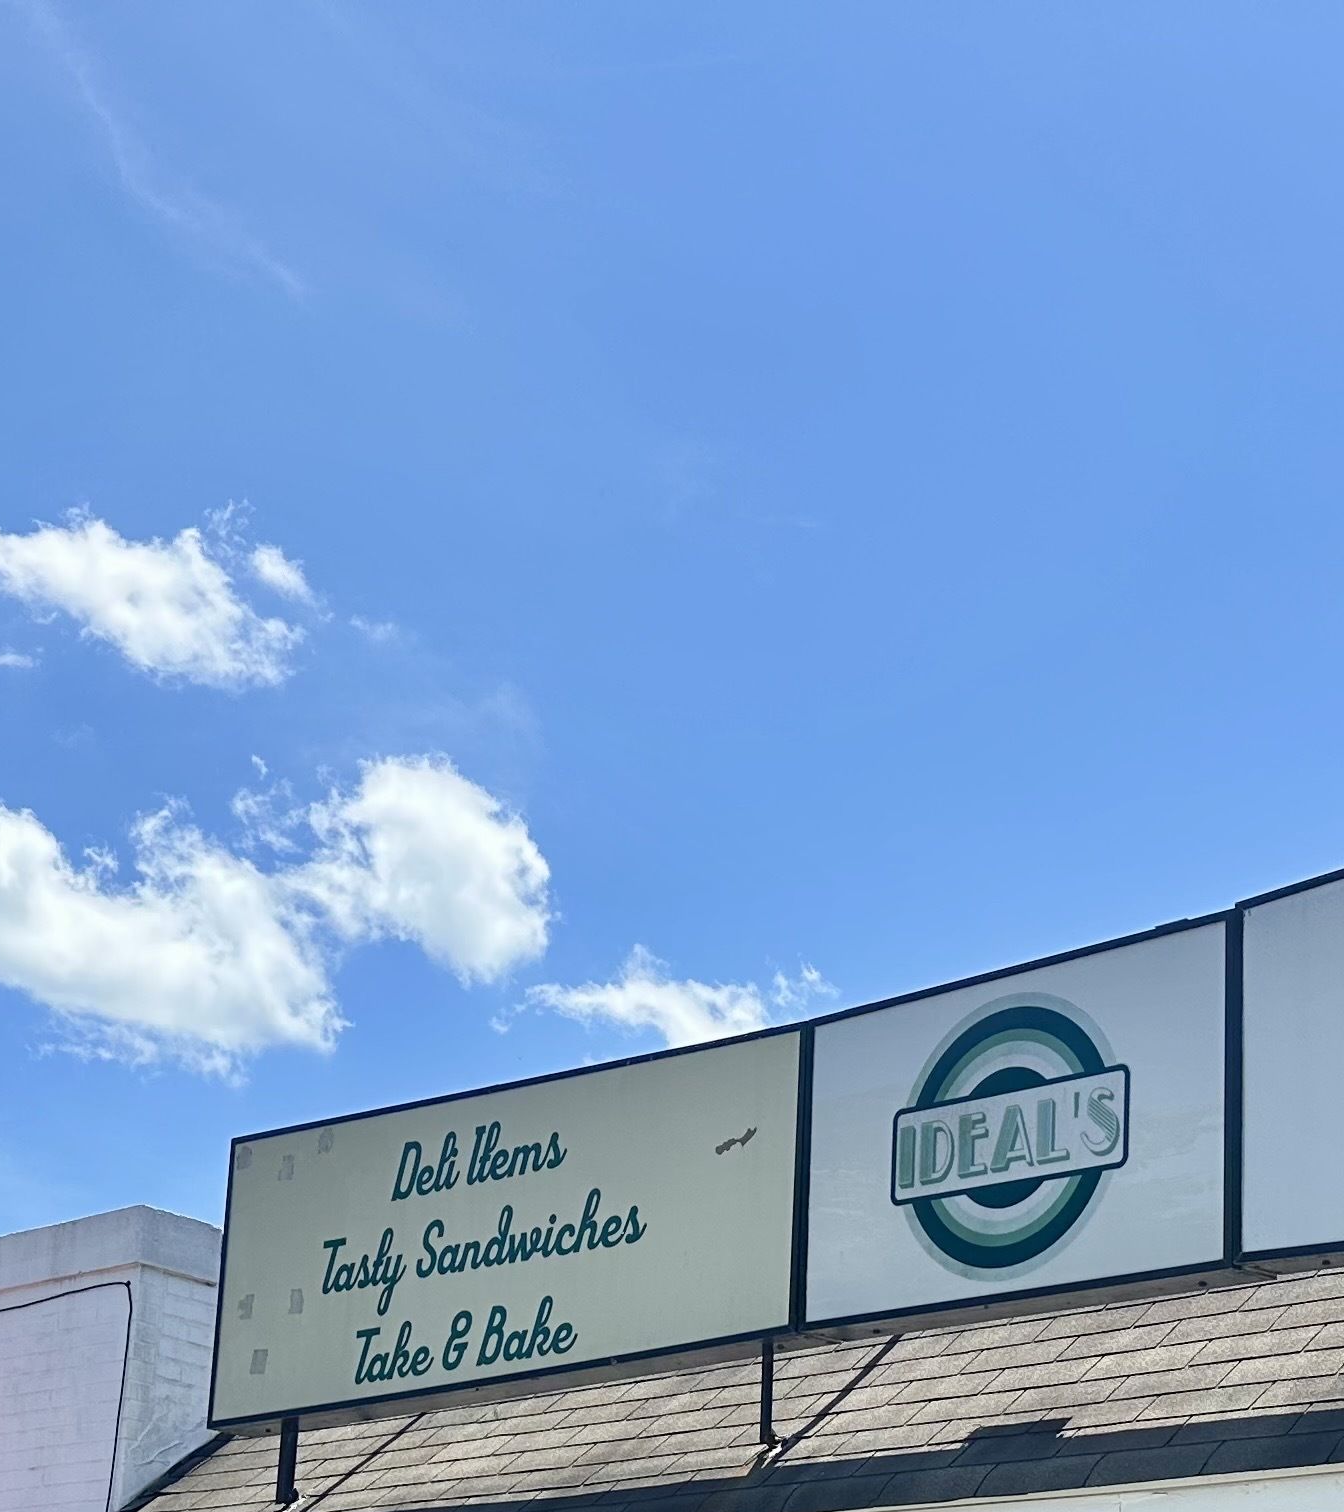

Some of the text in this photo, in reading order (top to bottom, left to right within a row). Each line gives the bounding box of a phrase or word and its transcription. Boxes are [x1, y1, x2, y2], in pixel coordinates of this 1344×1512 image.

[390, 1121, 568, 1202] Deli Items
[898, 1086, 1122, 1190] IDEAL'S
[322, 1188, 648, 1316] Tasty Sandwiches
[354, 1296, 579, 1385] Take & Bake
